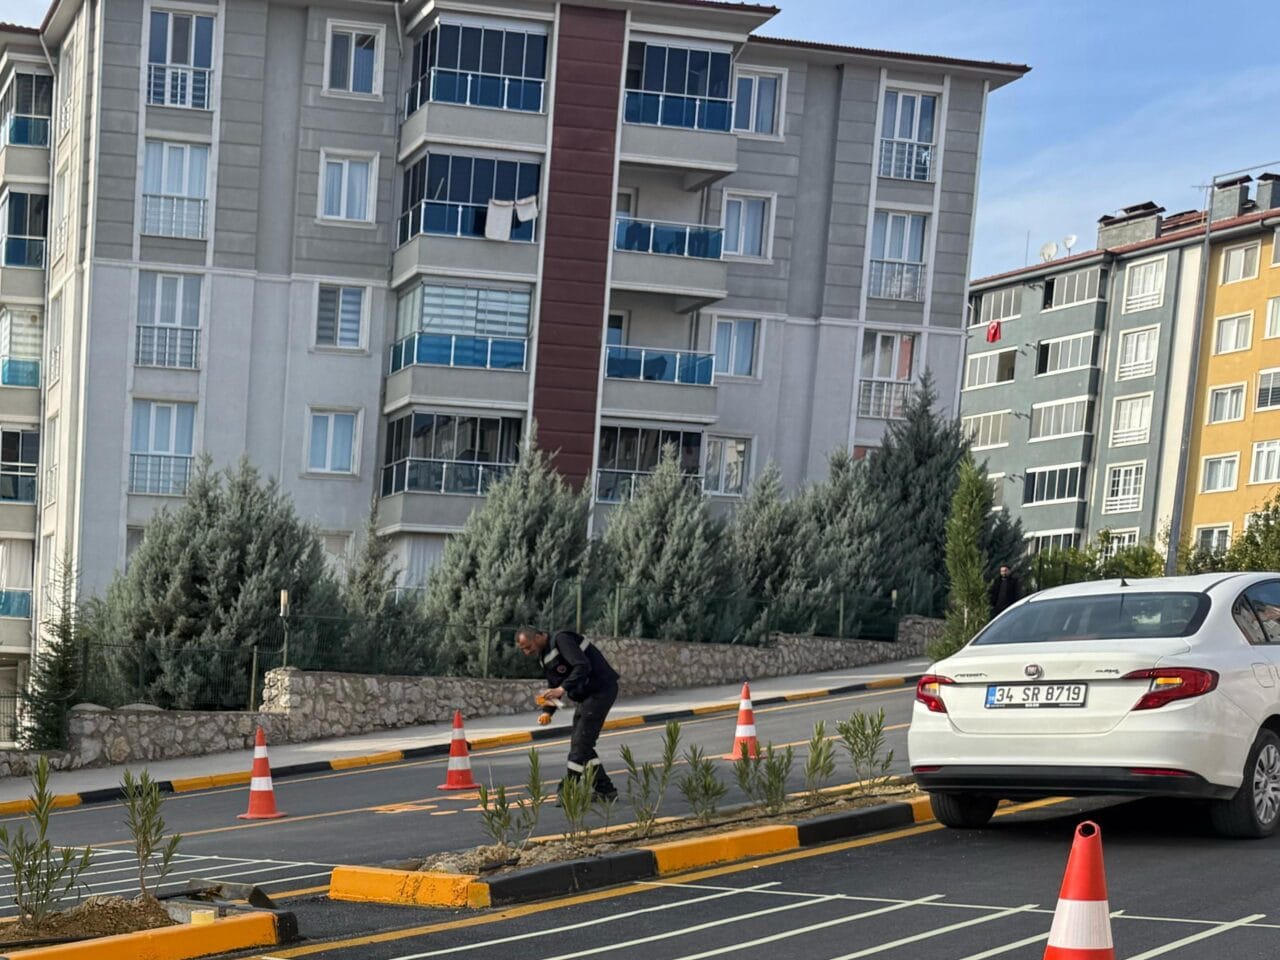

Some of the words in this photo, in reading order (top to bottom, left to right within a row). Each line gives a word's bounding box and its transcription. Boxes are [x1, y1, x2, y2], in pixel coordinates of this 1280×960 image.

[996, 687, 1014, 702] 34
[1022, 687, 1040, 701] SR
[1045, 686, 1081, 702] 8719
